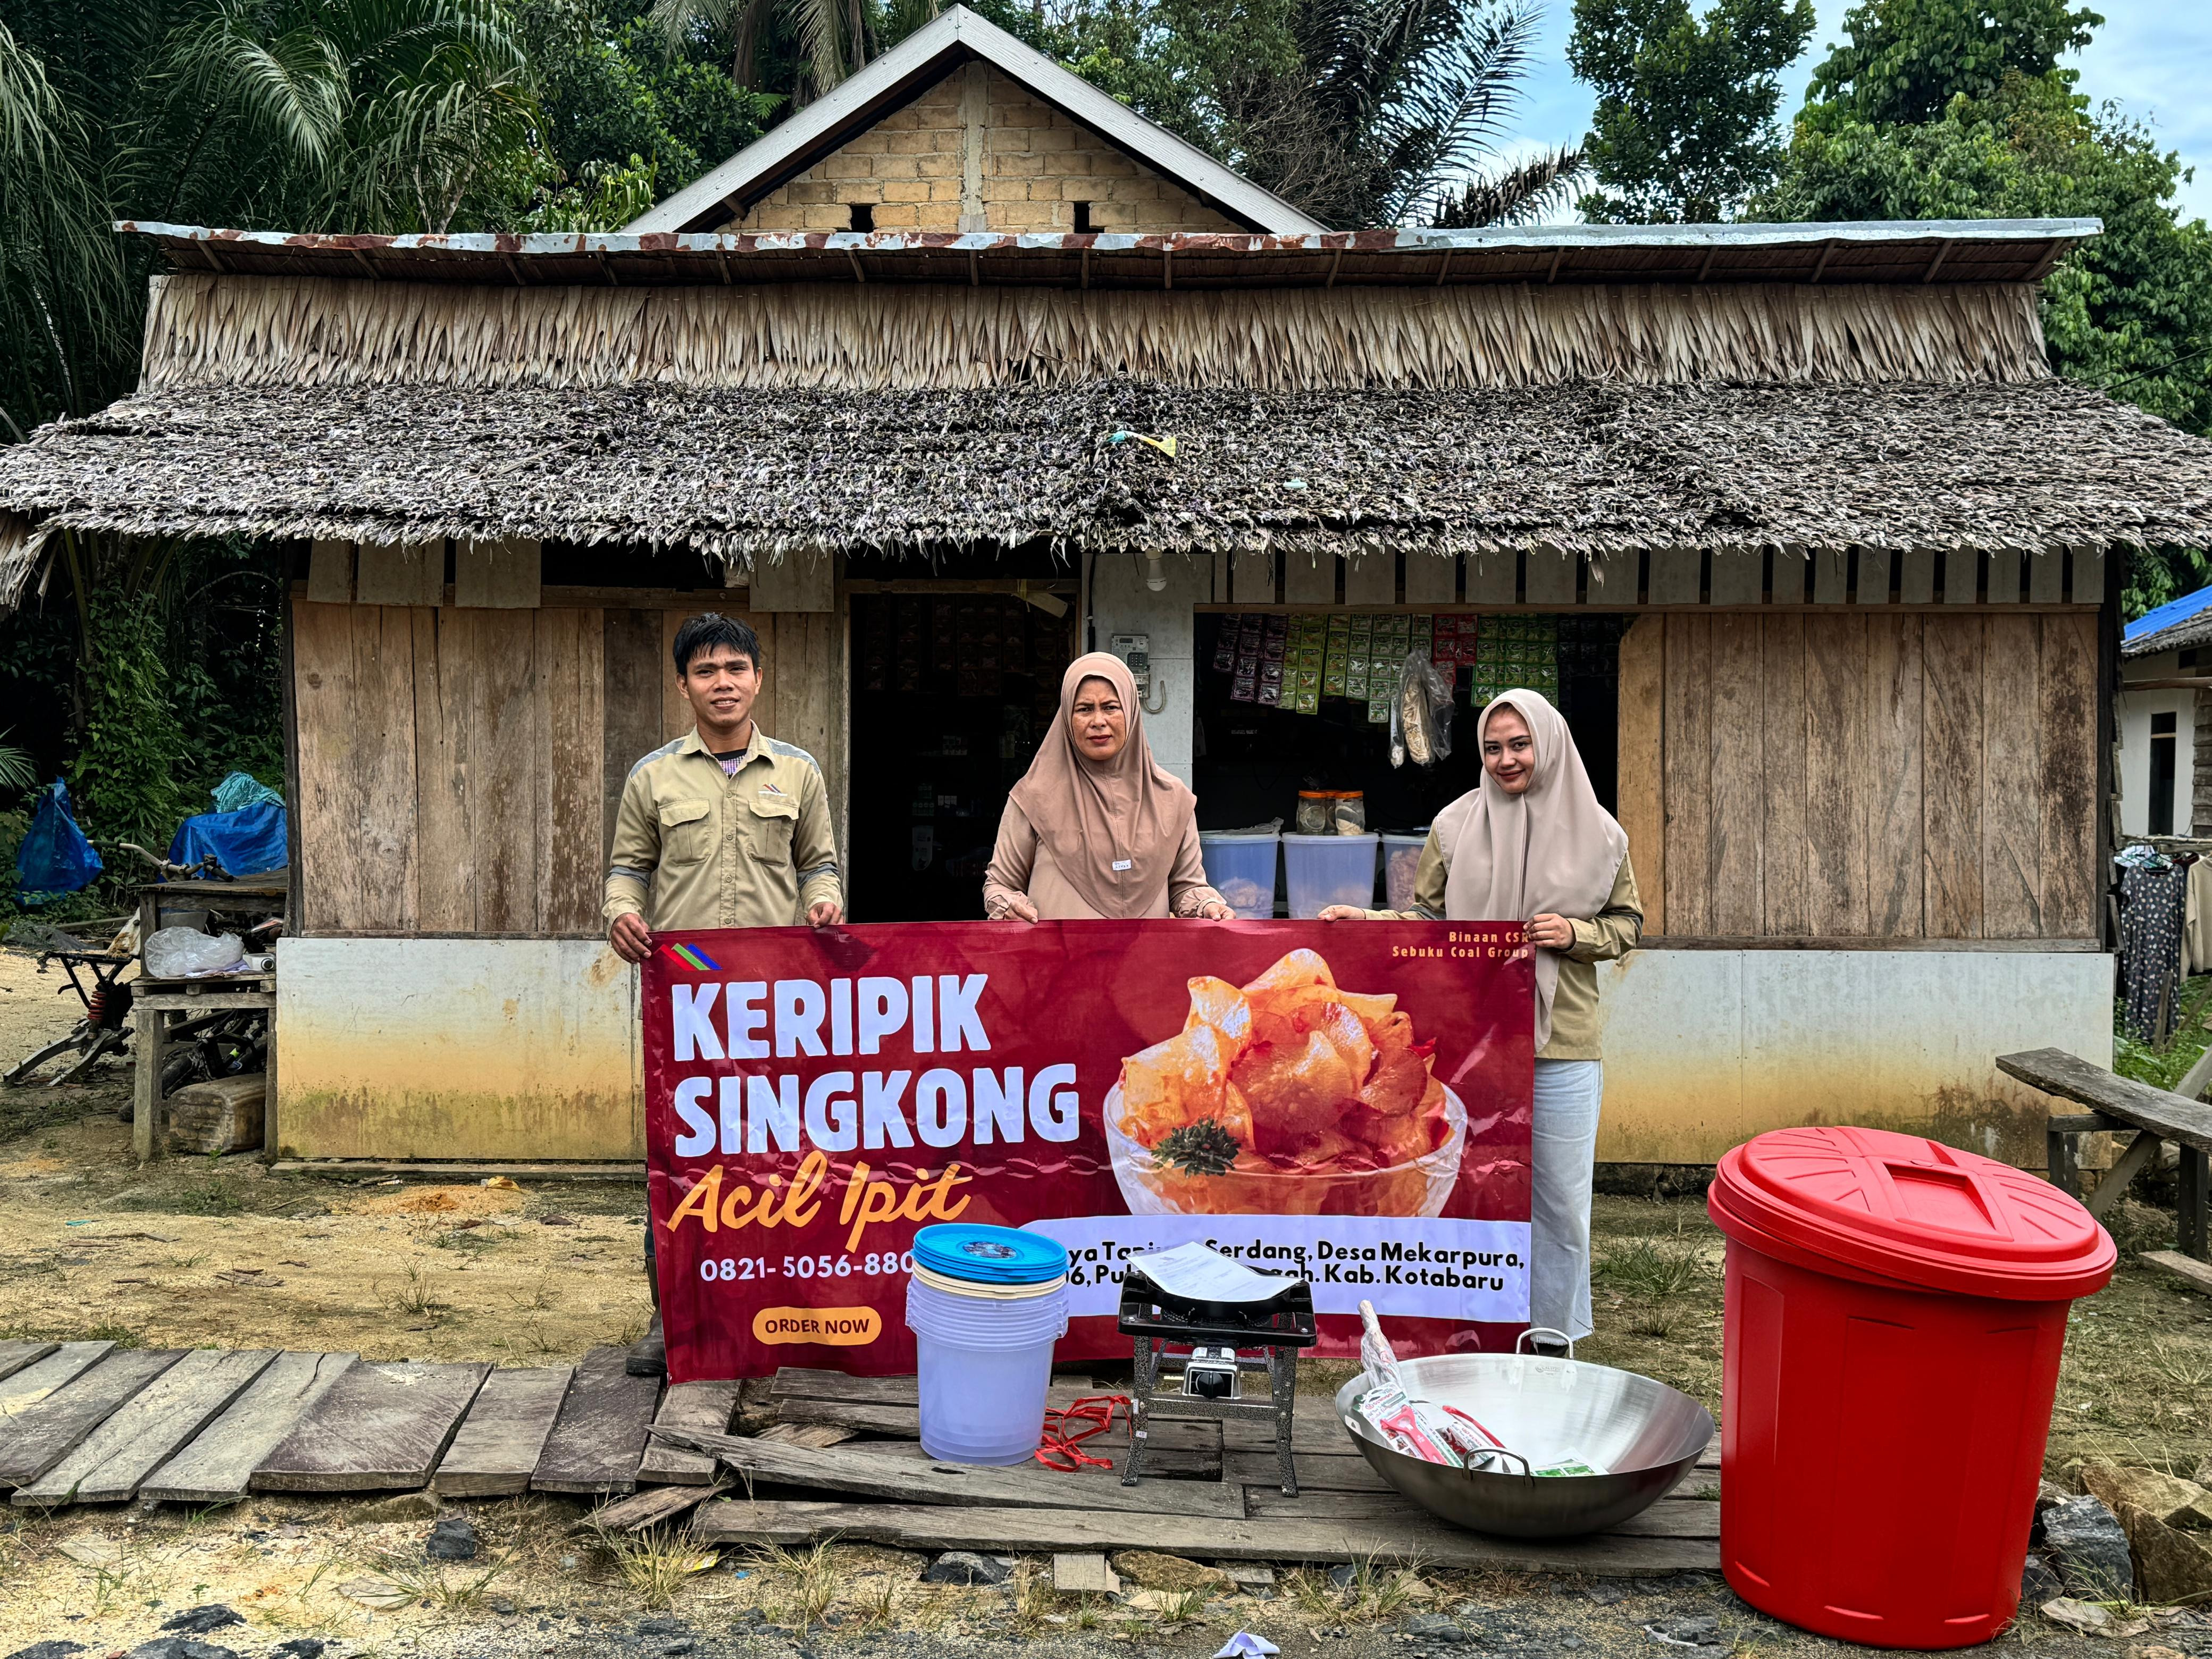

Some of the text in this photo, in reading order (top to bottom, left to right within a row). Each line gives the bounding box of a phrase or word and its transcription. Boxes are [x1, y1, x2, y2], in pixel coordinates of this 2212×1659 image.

[1449, 931, 1529, 943] Binaan CSR
[1392, 945, 1529, 959] Sebuku Coal Group
[672, 974, 991, 1061] KERIPIK
[674, 1063, 1079, 1158] SINGKONG
[666, 1150, 974, 1253] Acil Ipit
[700, 1251, 915, 1282] 0821- 5056-880
[1067, 1247, 1098, 1268] ya
[1318, 1241, 1376, 1261] Desa
[1381, 1242, 1524, 1270] Mekarpura,
[1325, 1263, 1381, 1284] Kab.
[1386, 1265, 1504, 1291] Kotabaru
[765, 1318, 870, 1335] ORDER NOW
